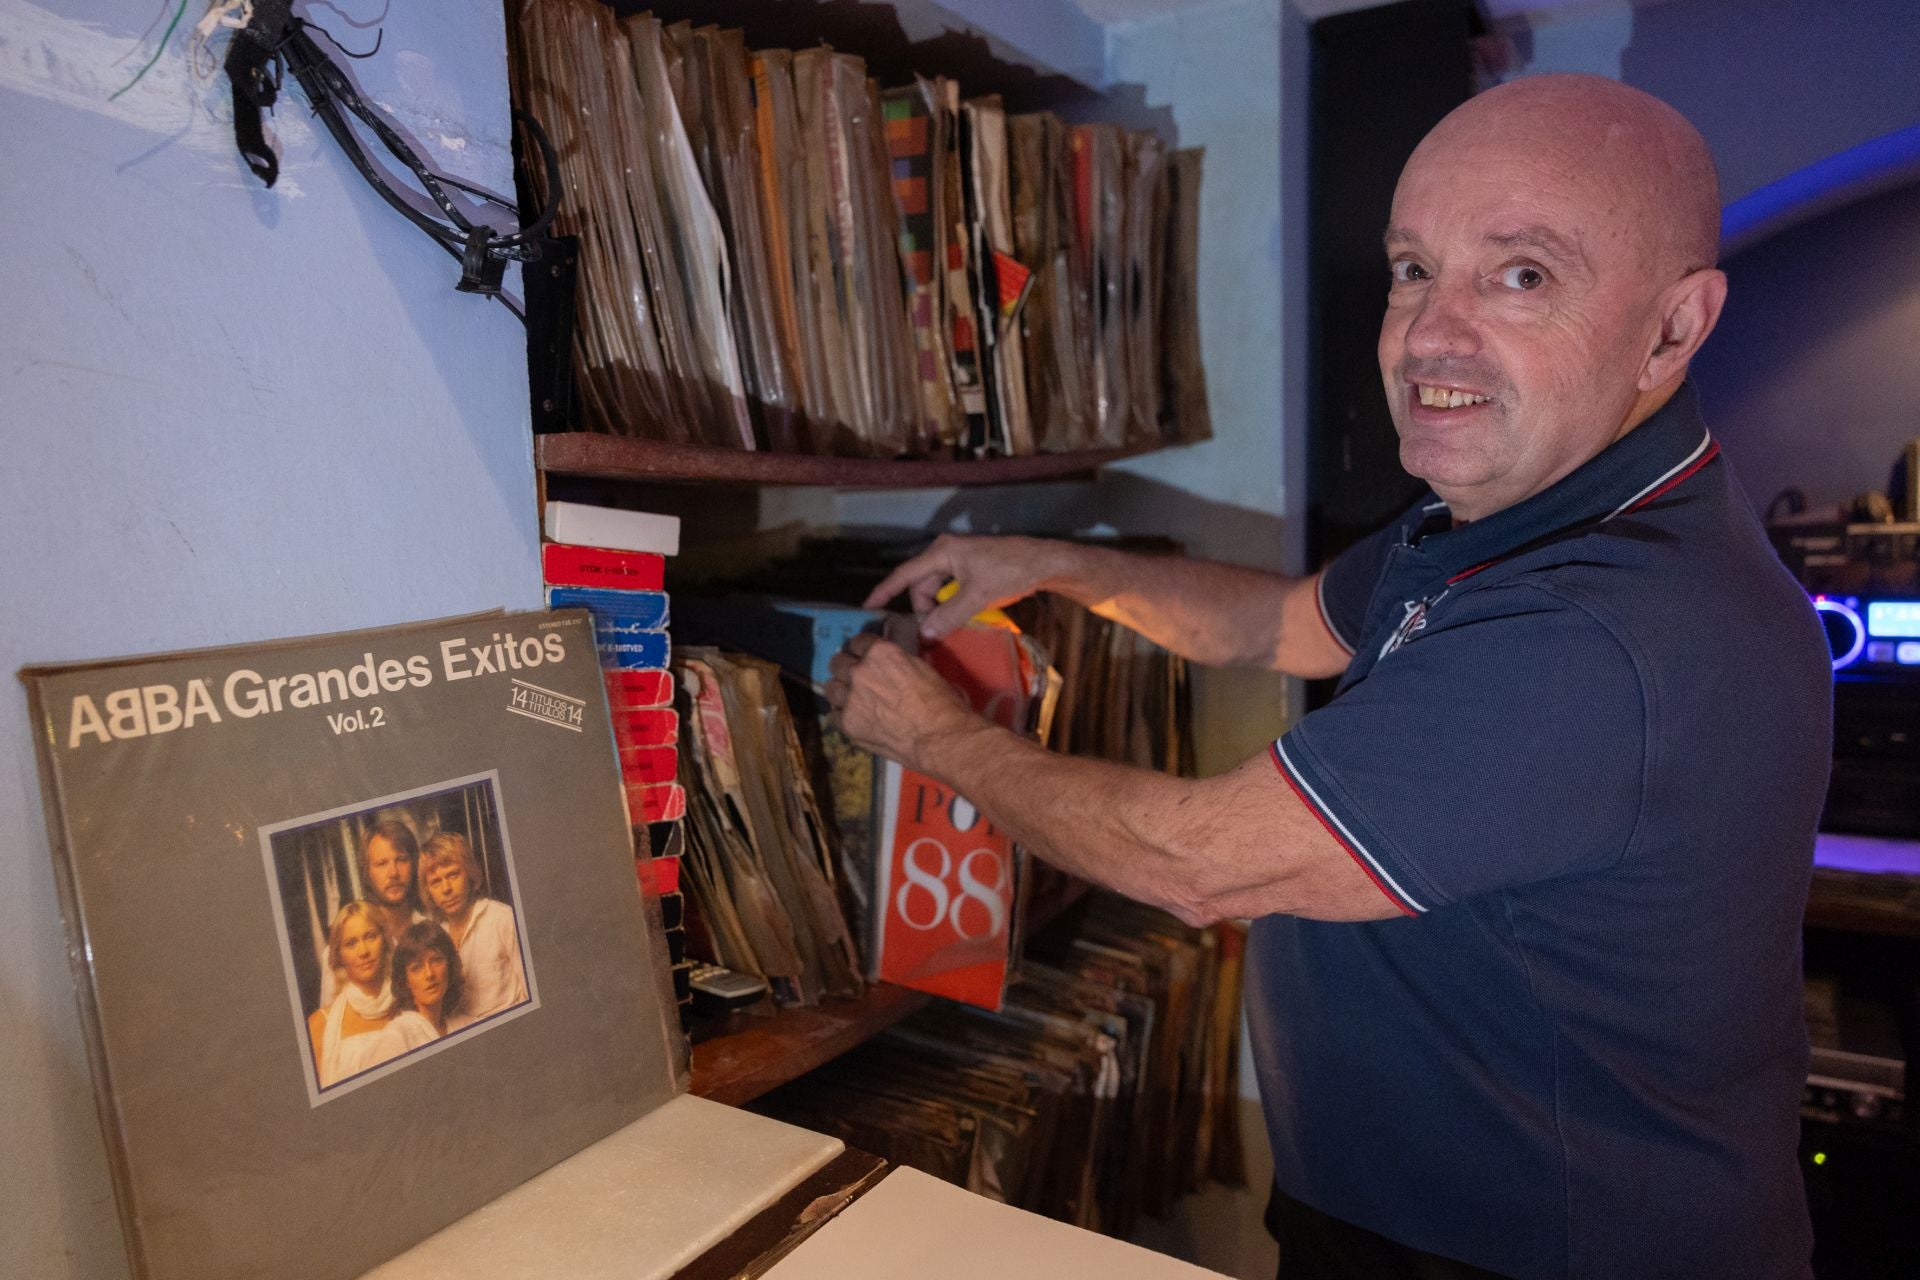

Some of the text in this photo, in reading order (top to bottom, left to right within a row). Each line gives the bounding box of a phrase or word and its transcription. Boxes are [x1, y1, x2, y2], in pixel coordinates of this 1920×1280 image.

[69, 632, 566, 749] ABBA Grandes Exitos
[511, 686, 567, 711] 14 TITULOS
[528, 700, 584, 726] TITULOS 14
[914, 782, 995, 838] PO
[897, 836, 1006, 940] 88
